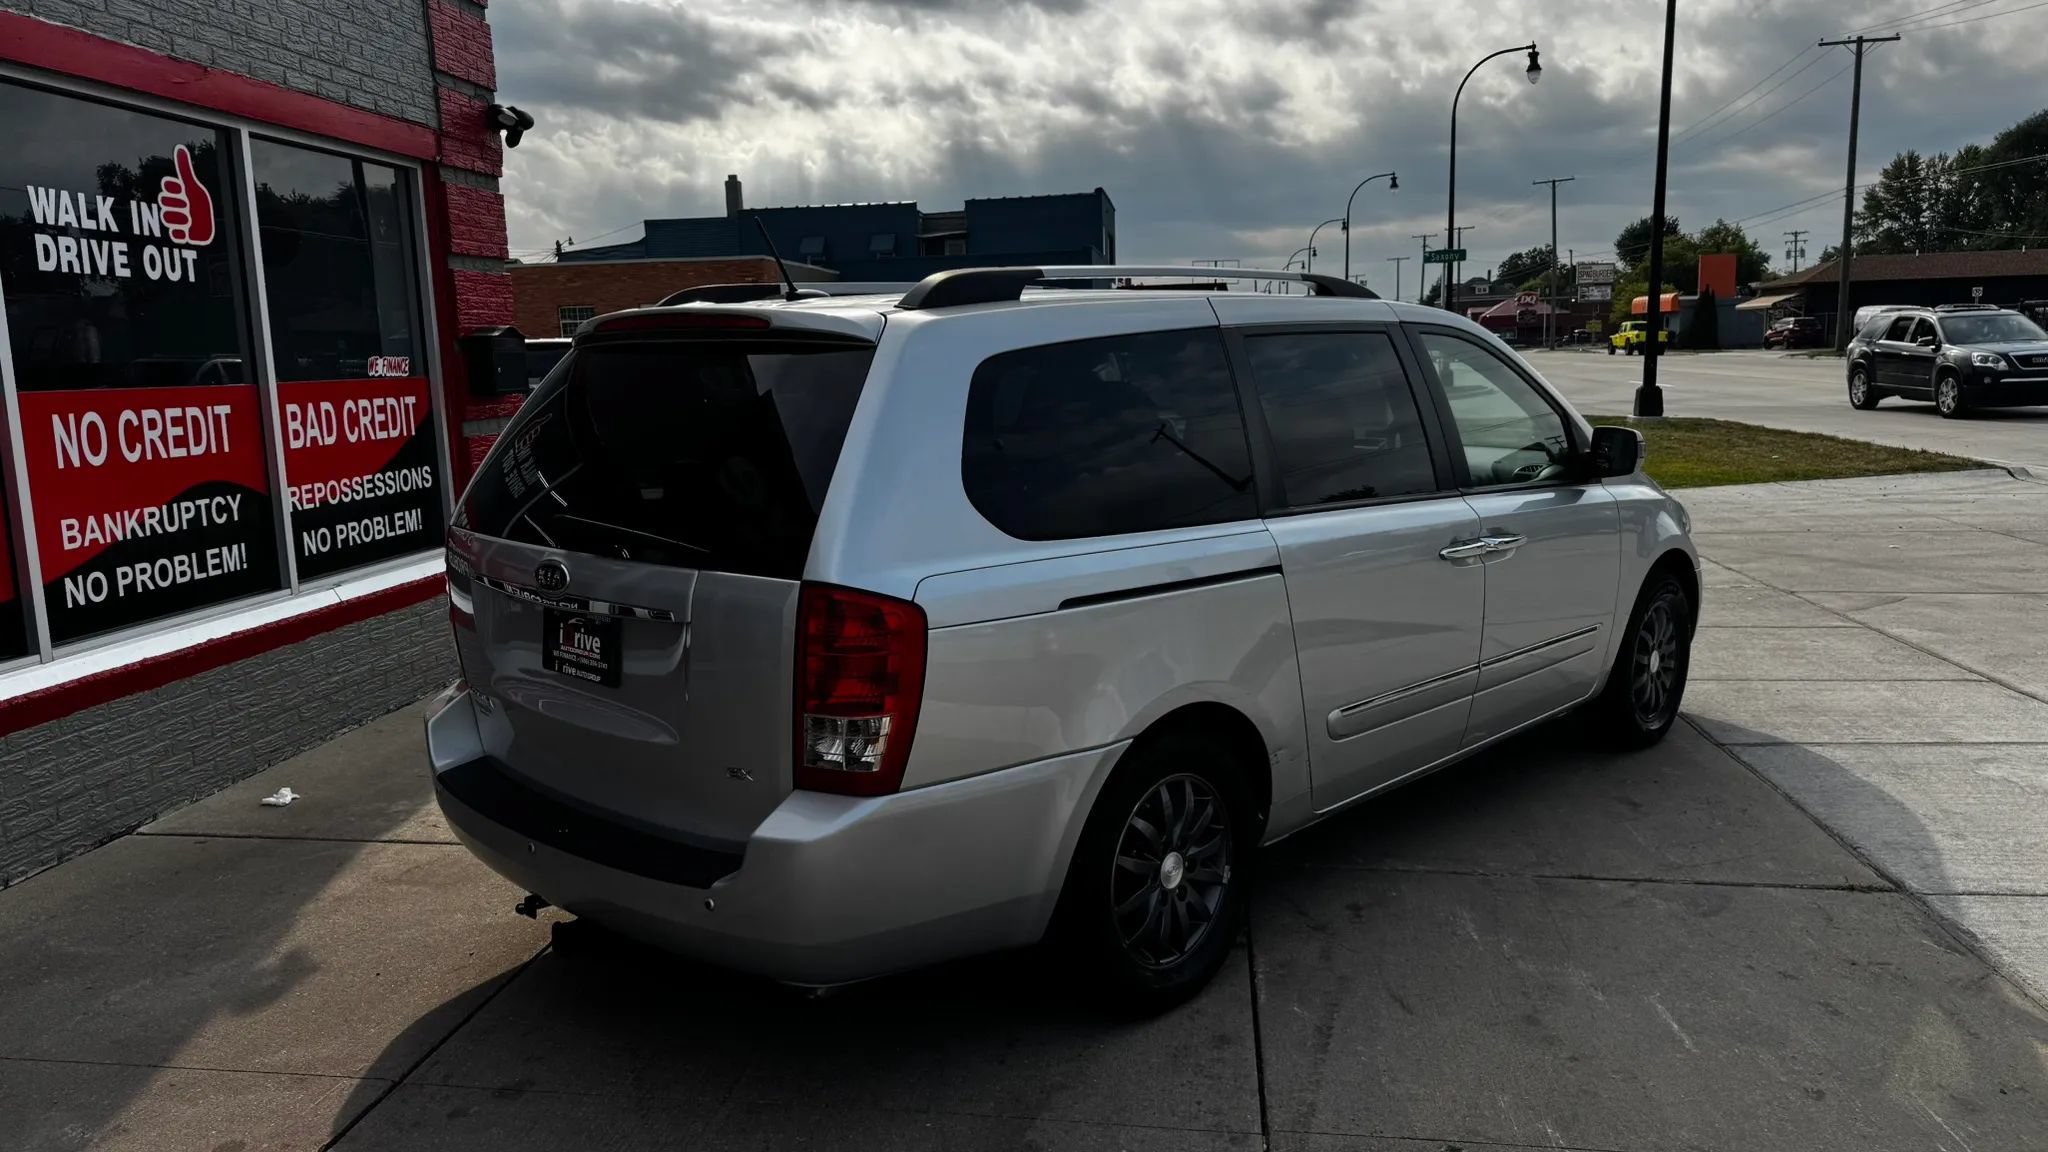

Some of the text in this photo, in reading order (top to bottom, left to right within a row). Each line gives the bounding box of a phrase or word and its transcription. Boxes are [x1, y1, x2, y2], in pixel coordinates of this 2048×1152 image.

[27, 185, 161, 238] WALK IN
[35, 233, 198, 283] DRIVE OUT
[1431, 252, 1459, 261] Saxony
[1520, 295, 1537, 305] DQ
[368, 356, 410, 377] WE FINANCE
[51, 404, 232, 469] NO CREDIT
[287, 396, 417, 449] BAD CREDIT
[289, 466, 433, 512] REPOSSESSIONS
[61, 494, 242, 551] BANKRUPTCY
[304, 507, 423, 556] NO PROBLEM!
[64, 543, 248, 608] NO PROBLEM!
